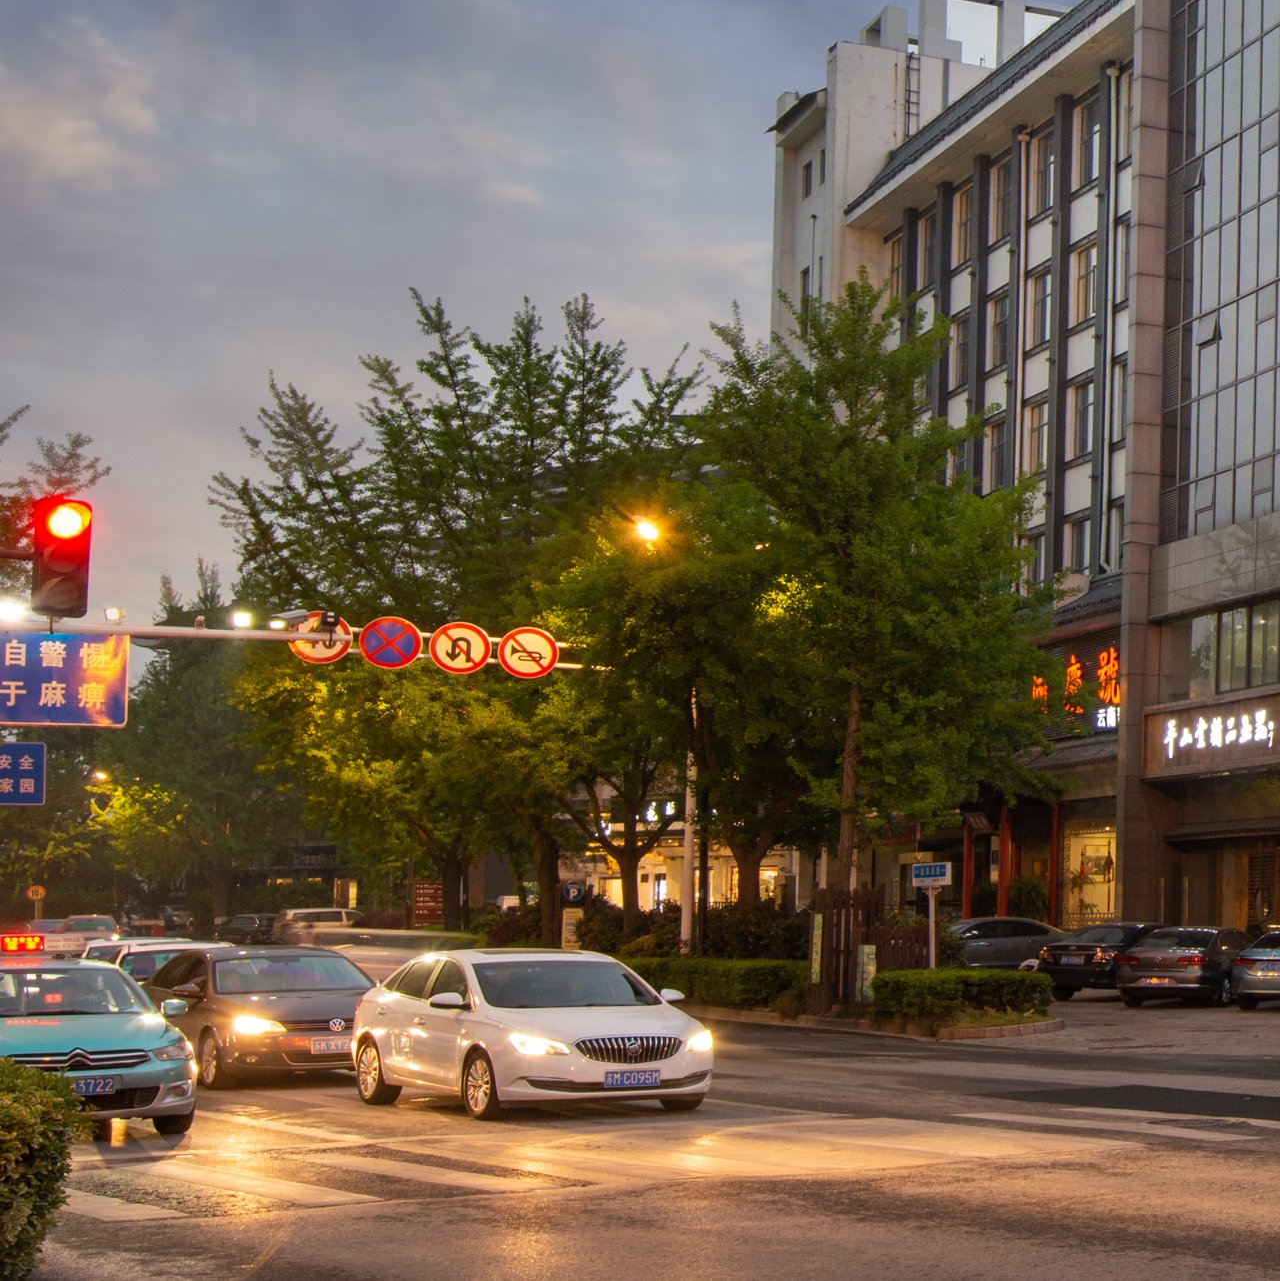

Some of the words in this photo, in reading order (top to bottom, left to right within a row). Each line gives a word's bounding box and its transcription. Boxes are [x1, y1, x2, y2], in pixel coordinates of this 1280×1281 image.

[5, 640, 107, 669] 自警惕
[0, 681, 105, 709] 于麻痹
